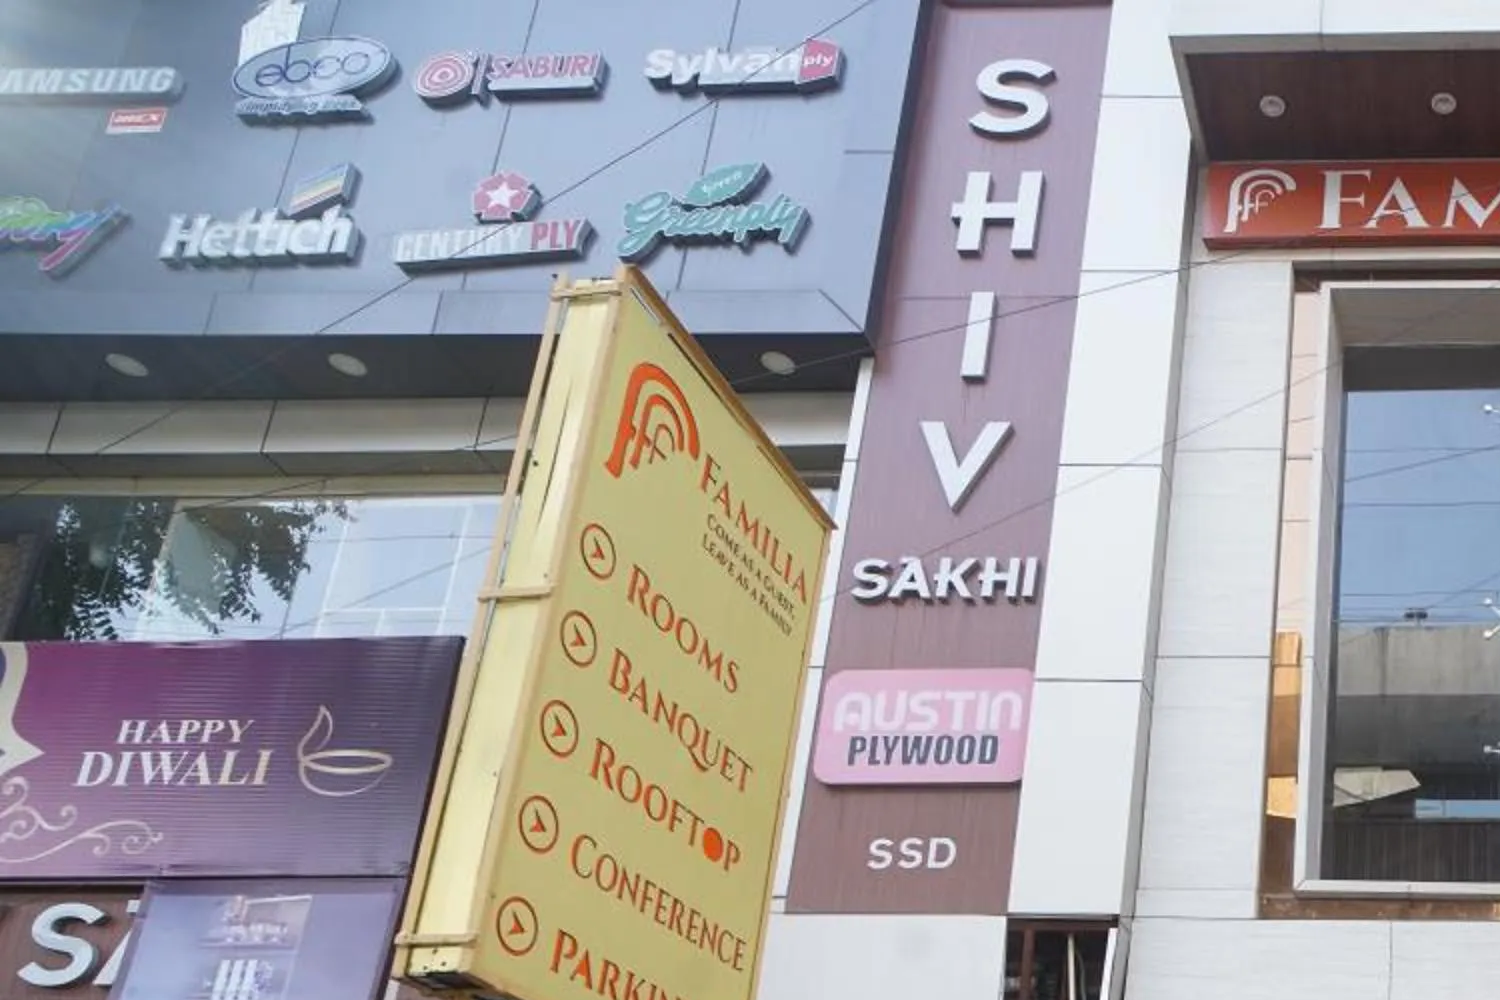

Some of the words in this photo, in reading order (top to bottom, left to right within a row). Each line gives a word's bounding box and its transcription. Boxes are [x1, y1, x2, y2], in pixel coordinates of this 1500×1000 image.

[0, 66, 177, 93] AMSUNG
[255, 45, 371, 87] ebco
[487, 52, 602, 81] SABURI
[644, 46, 801, 84] Sylvan
[804, 52, 835, 69] ply
[160, 206, 355, 260] Hettich
[396, 223, 525, 262] CENTURY
[530, 219, 580, 250] PLY
[616, 190, 810, 260] Greenply
[698, 453, 808, 605] FAMILIA
[852, 555, 1041, 603] SAKHI
[626, 564, 740, 695] ROOMS
[116, 719, 254, 745] HAPPY
[607, 648, 754, 794] BANQUET
[73, 748, 276, 788] DIWALI
[847, 735, 999, 767] PLYWOOD
[588, 737, 743, 872] ROOFTOP
[868, 838, 957, 870] SSD
[570, 832, 748, 973] CONFERENCE
